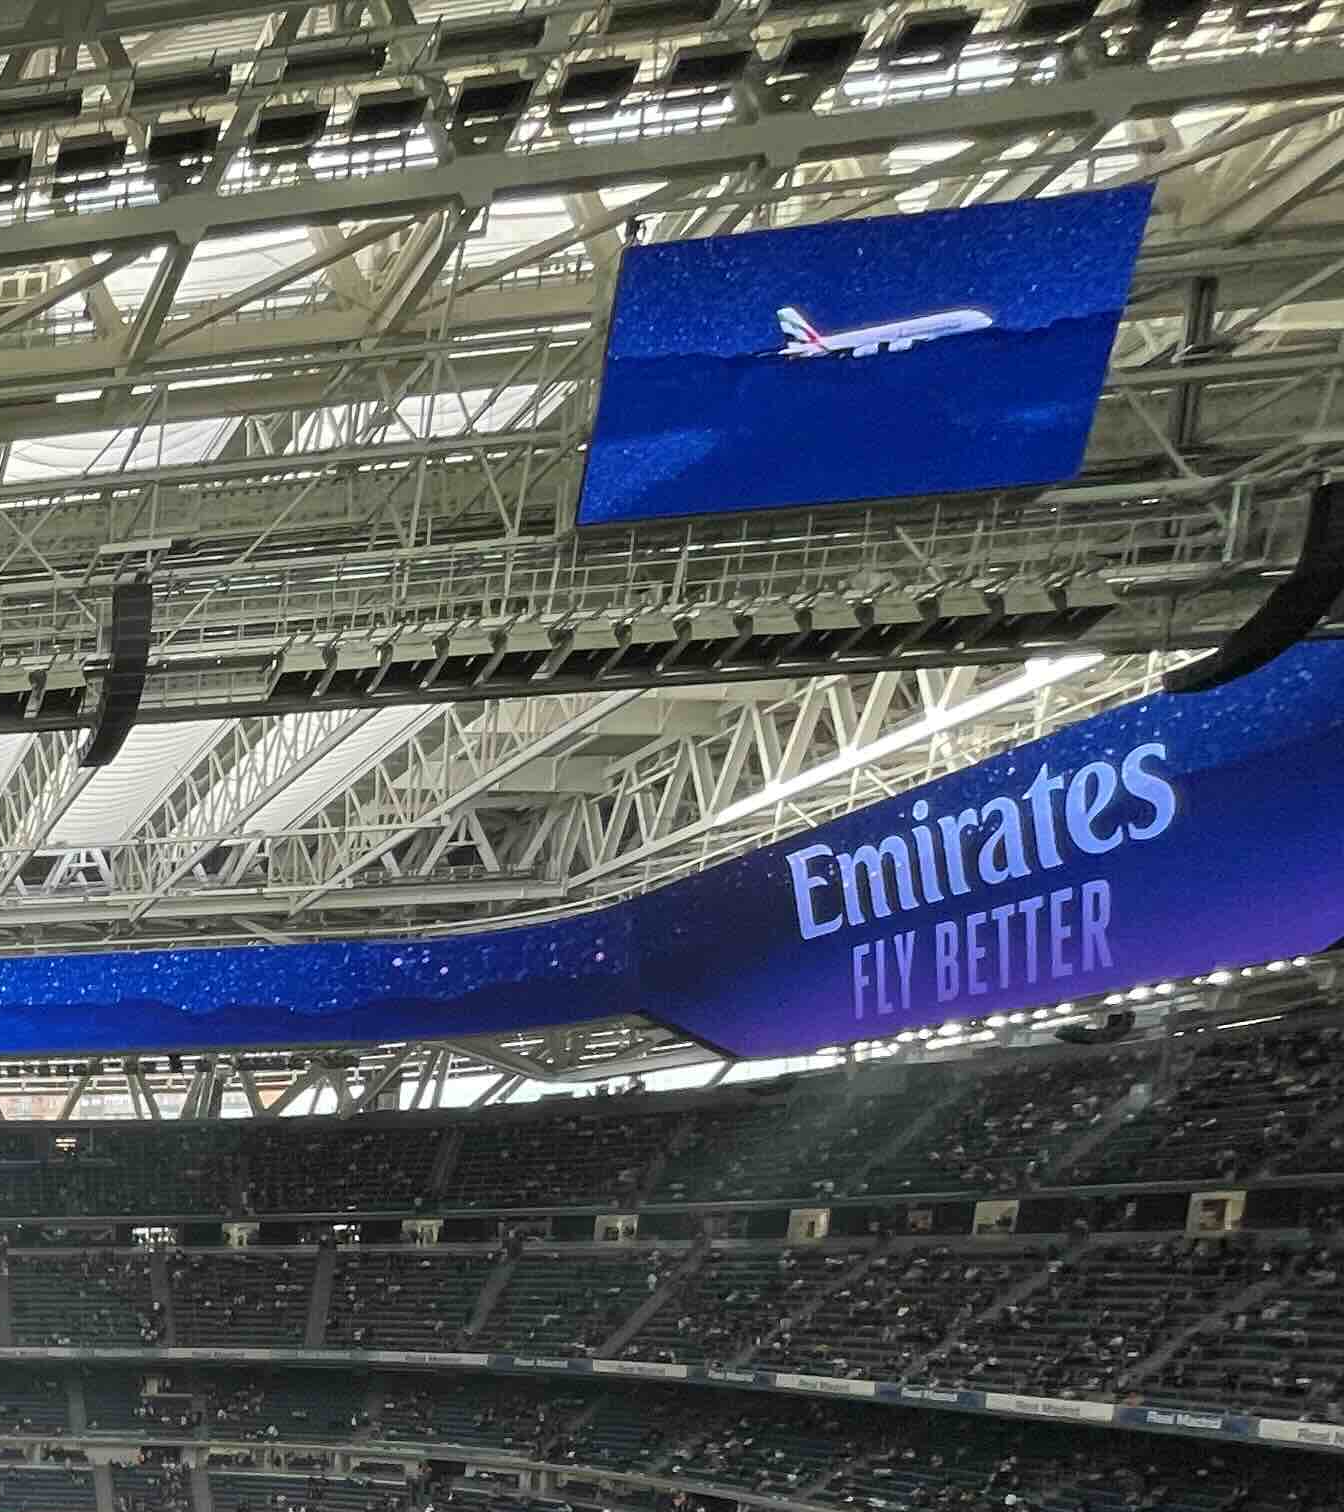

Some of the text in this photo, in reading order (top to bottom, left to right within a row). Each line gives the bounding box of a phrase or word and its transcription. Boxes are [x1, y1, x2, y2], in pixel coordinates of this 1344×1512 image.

[785, 743, 1178, 940] Emirates
[853, 879, 1114, 1020] FLY BETTER
